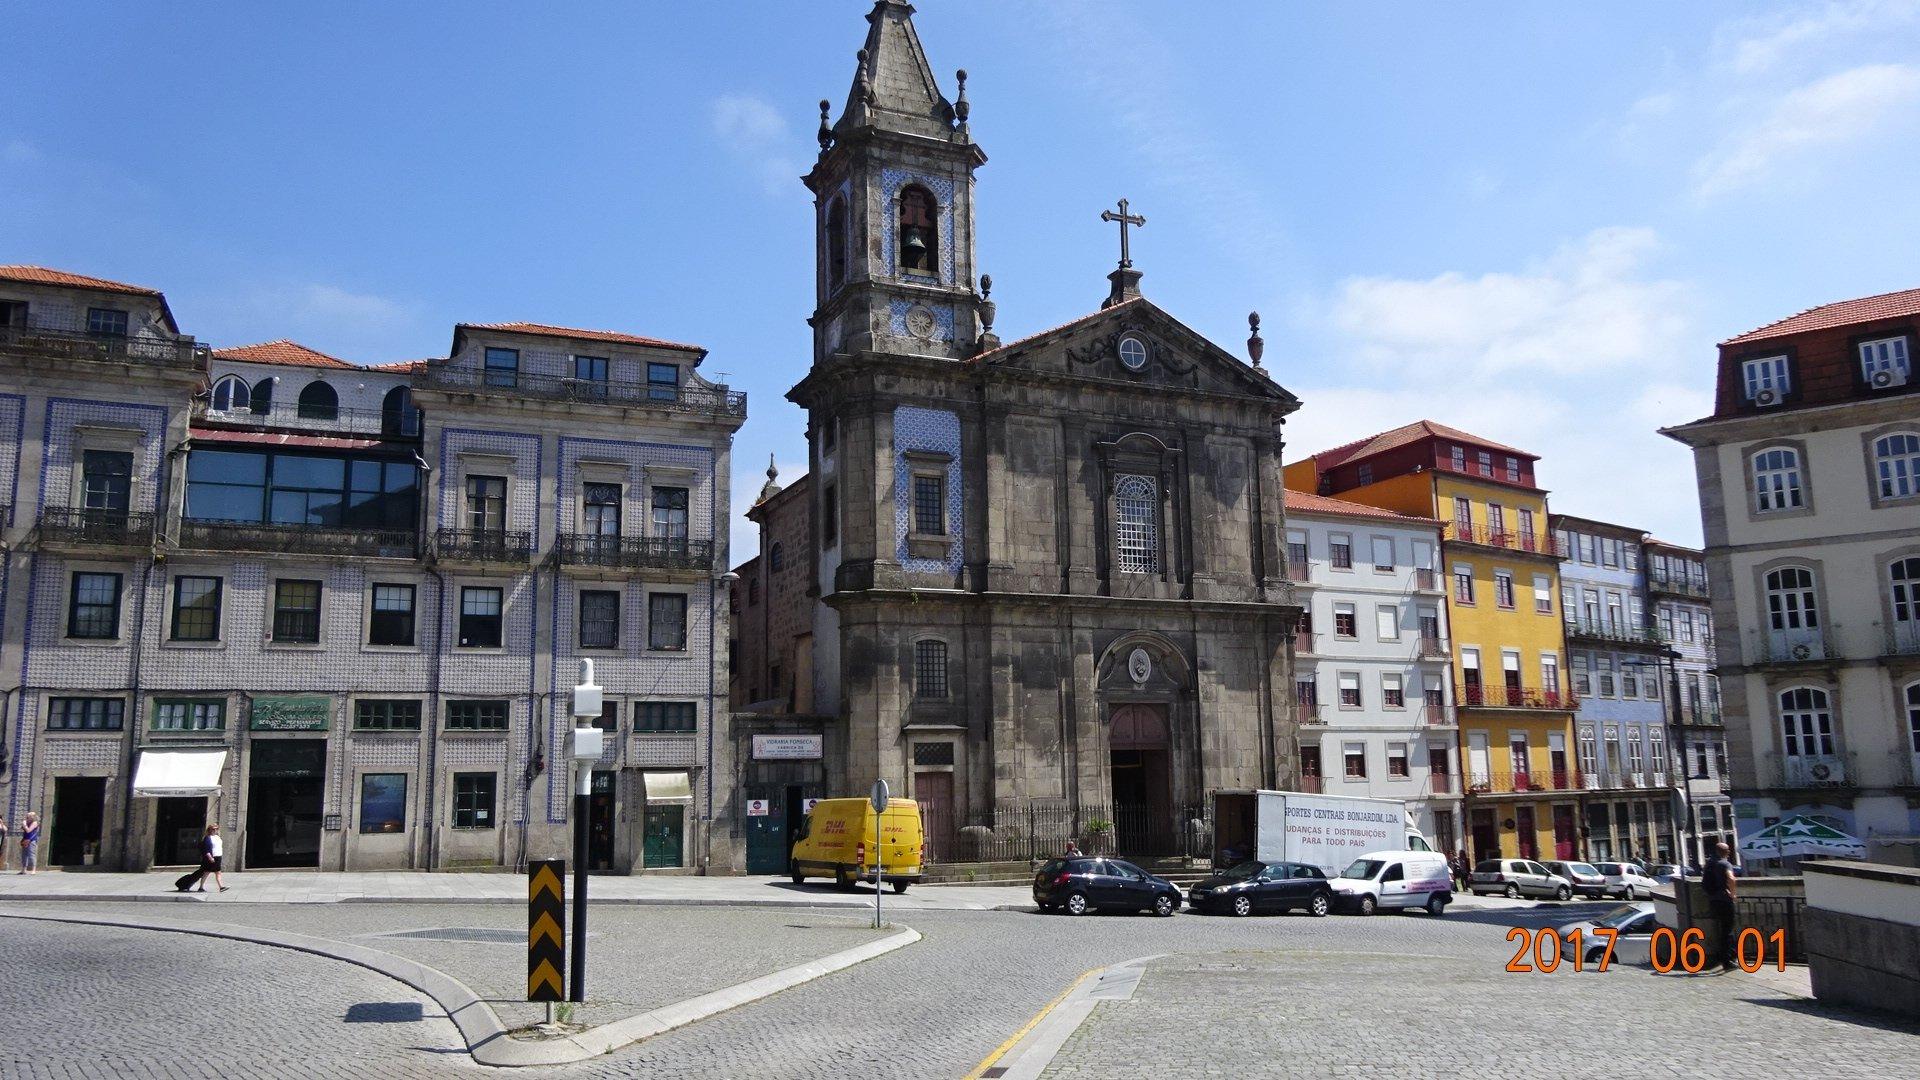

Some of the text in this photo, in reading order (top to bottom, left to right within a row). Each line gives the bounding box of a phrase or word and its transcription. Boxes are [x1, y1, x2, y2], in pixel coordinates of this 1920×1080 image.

[1314, 808, 1345, 820] CENTRAIS
[1286, 825, 1322, 836] UDANÇAS
[1325, 827, 1331, 835] E
[1301, 836, 1322, 845] PARA
[1325, 837, 1346, 846] TODO
